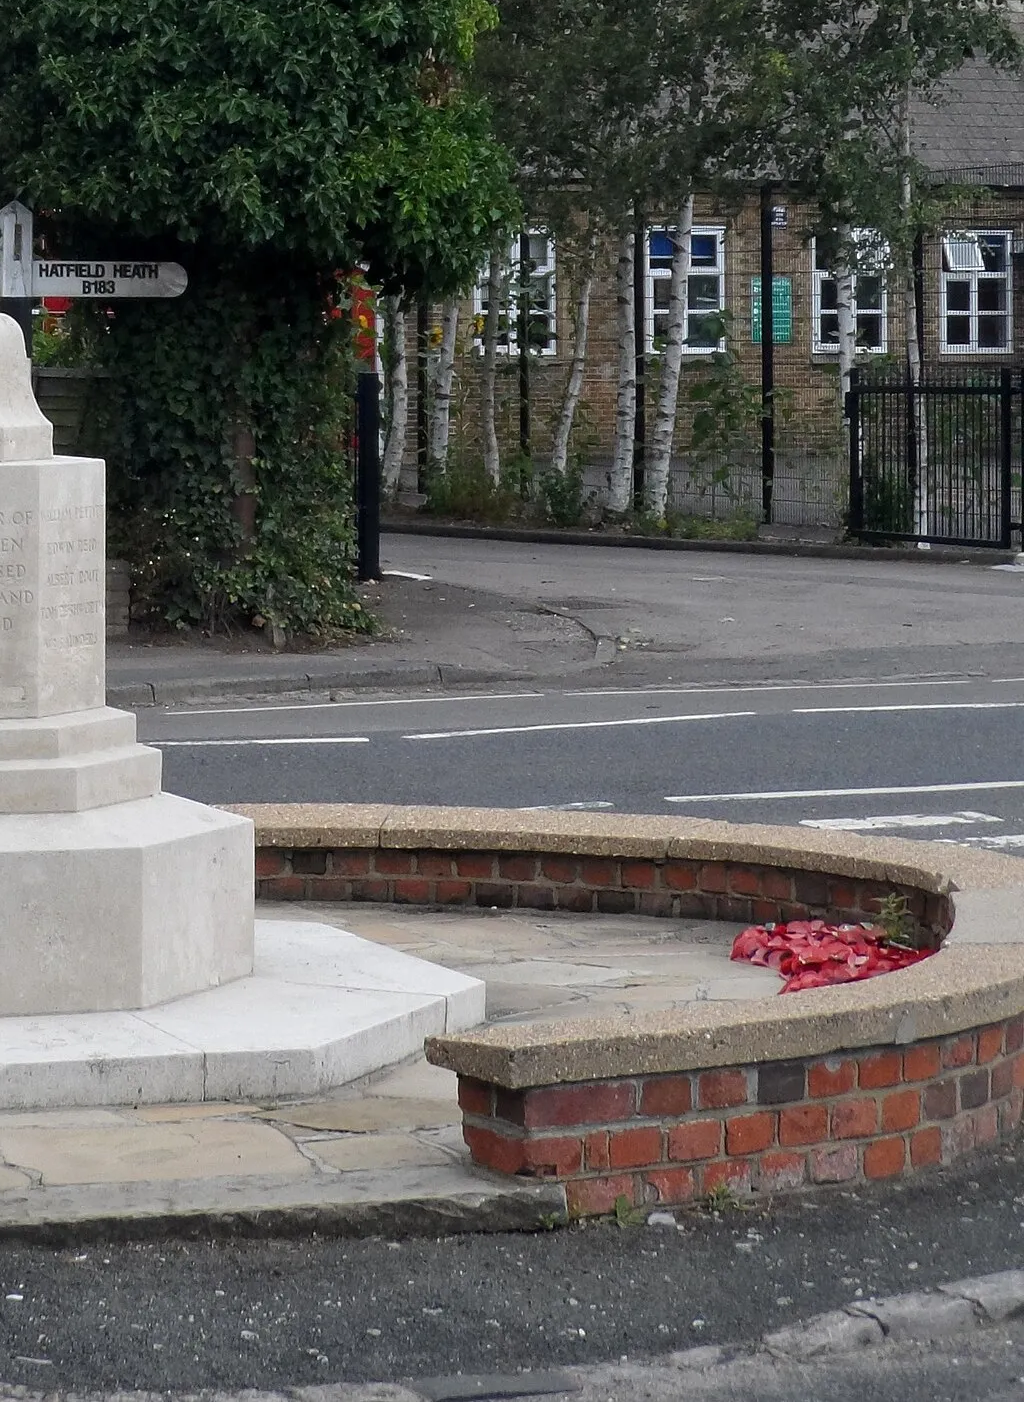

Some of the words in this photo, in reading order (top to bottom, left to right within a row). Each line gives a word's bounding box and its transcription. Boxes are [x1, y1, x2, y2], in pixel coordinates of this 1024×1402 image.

[38, 264, 106, 279] HATFIELD
[113, 264, 159, 279] HEATH
[82, 280, 116, 294] B183
[12, 510, 34, 526] OF
